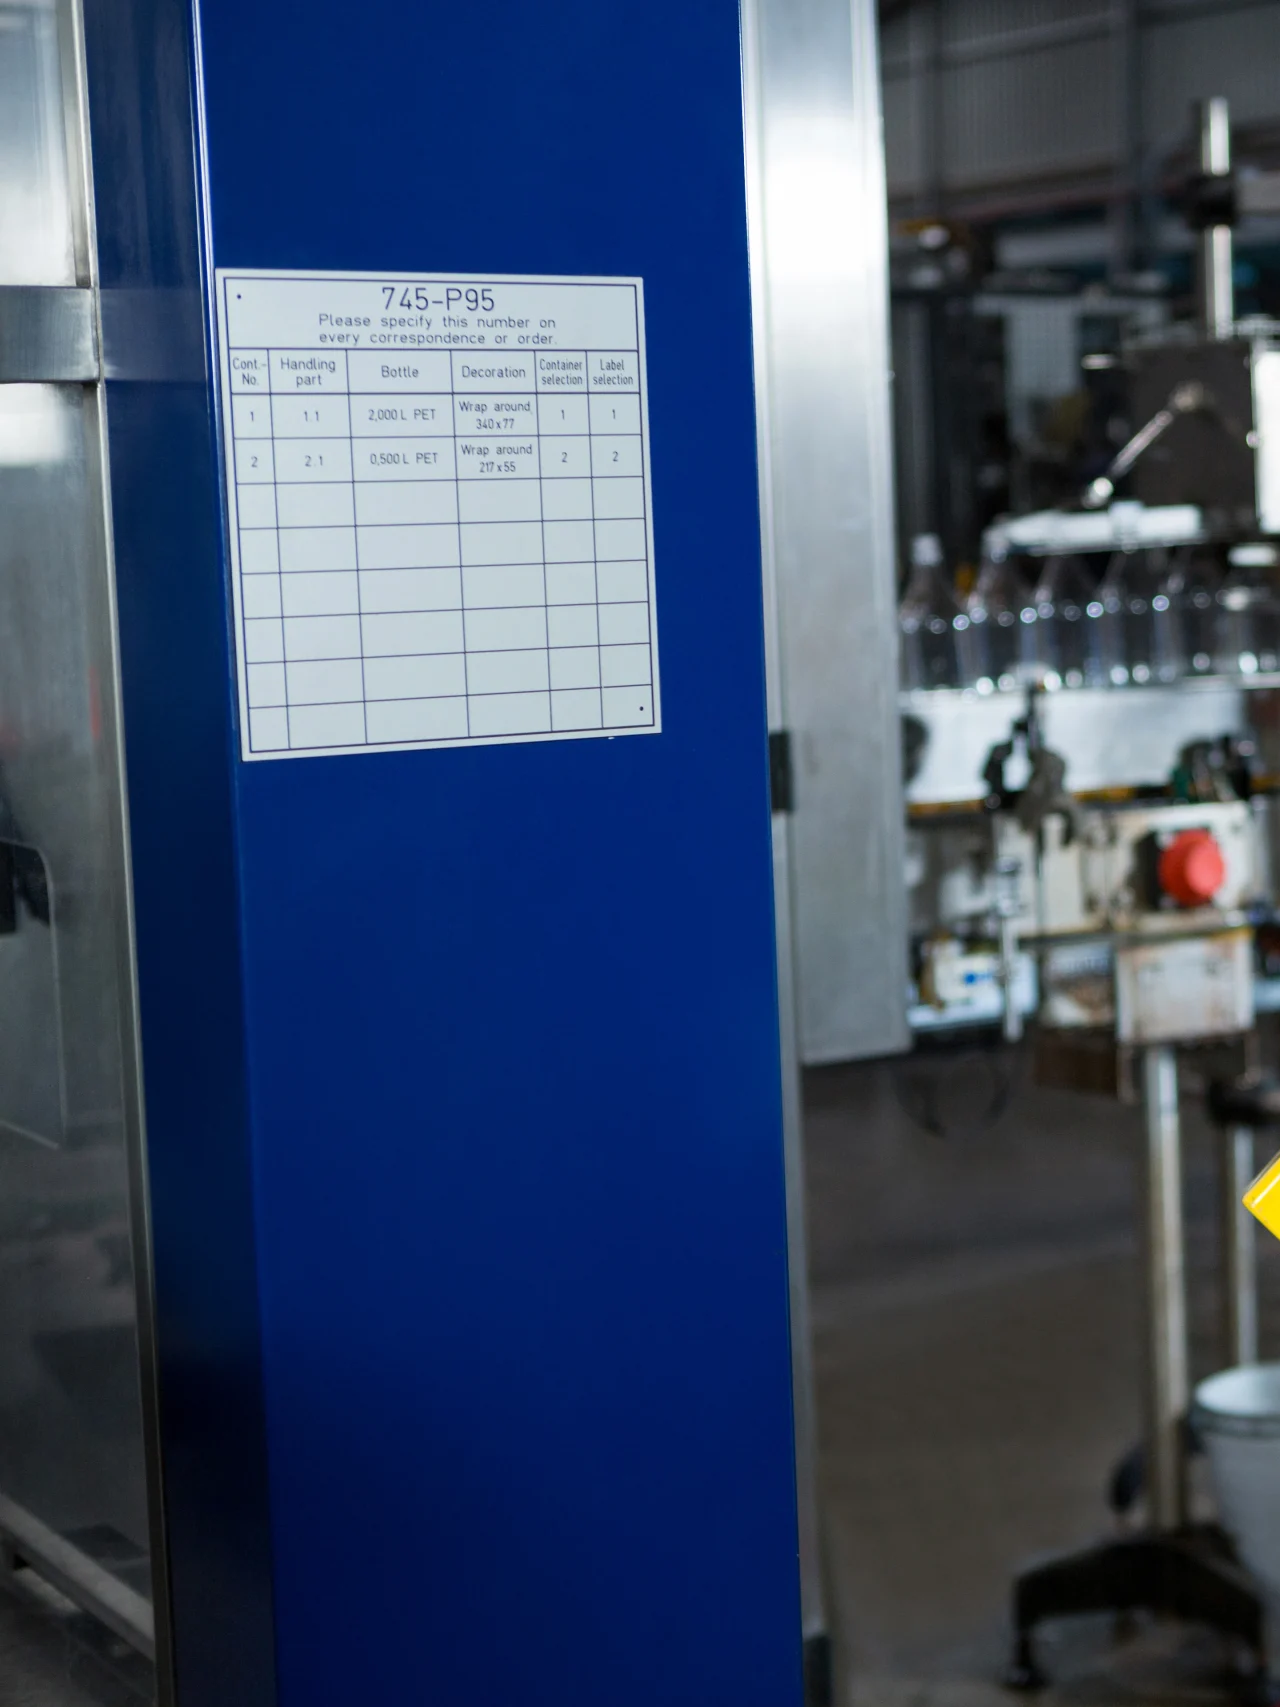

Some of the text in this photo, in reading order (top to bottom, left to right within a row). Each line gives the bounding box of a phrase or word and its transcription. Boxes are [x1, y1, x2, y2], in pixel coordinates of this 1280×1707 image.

[382, 287, 495, 312] 745-P95
[318, 313, 556, 330] Please specify this number on
[319, 331, 557, 346] every correspondence or order.
[280, 358, 336, 373] Handling
[539, 358, 583, 371] Container
[599, 359, 625, 371] Label
[380, 365, 419, 378] Bottle
[461, 365, 526, 379] Decoration
[241, 373, 259, 386] No.
[296, 374, 322, 388] part
[541, 373, 583, 386] selection
[592, 374, 634, 386] selection
[458, 401, 531, 413] Wrap around
[249, 411, 255, 422] 1
[413, 409, 436, 421] PET
[561, 409, 566, 420] 1
[611, 409, 617, 420] 1
[460, 443, 533, 457] Wrap around
[612, 451, 619, 462] 2
[251, 456, 258, 468] 2
[415, 452, 438, 465] PET
[561, 452, 568, 463] 2
